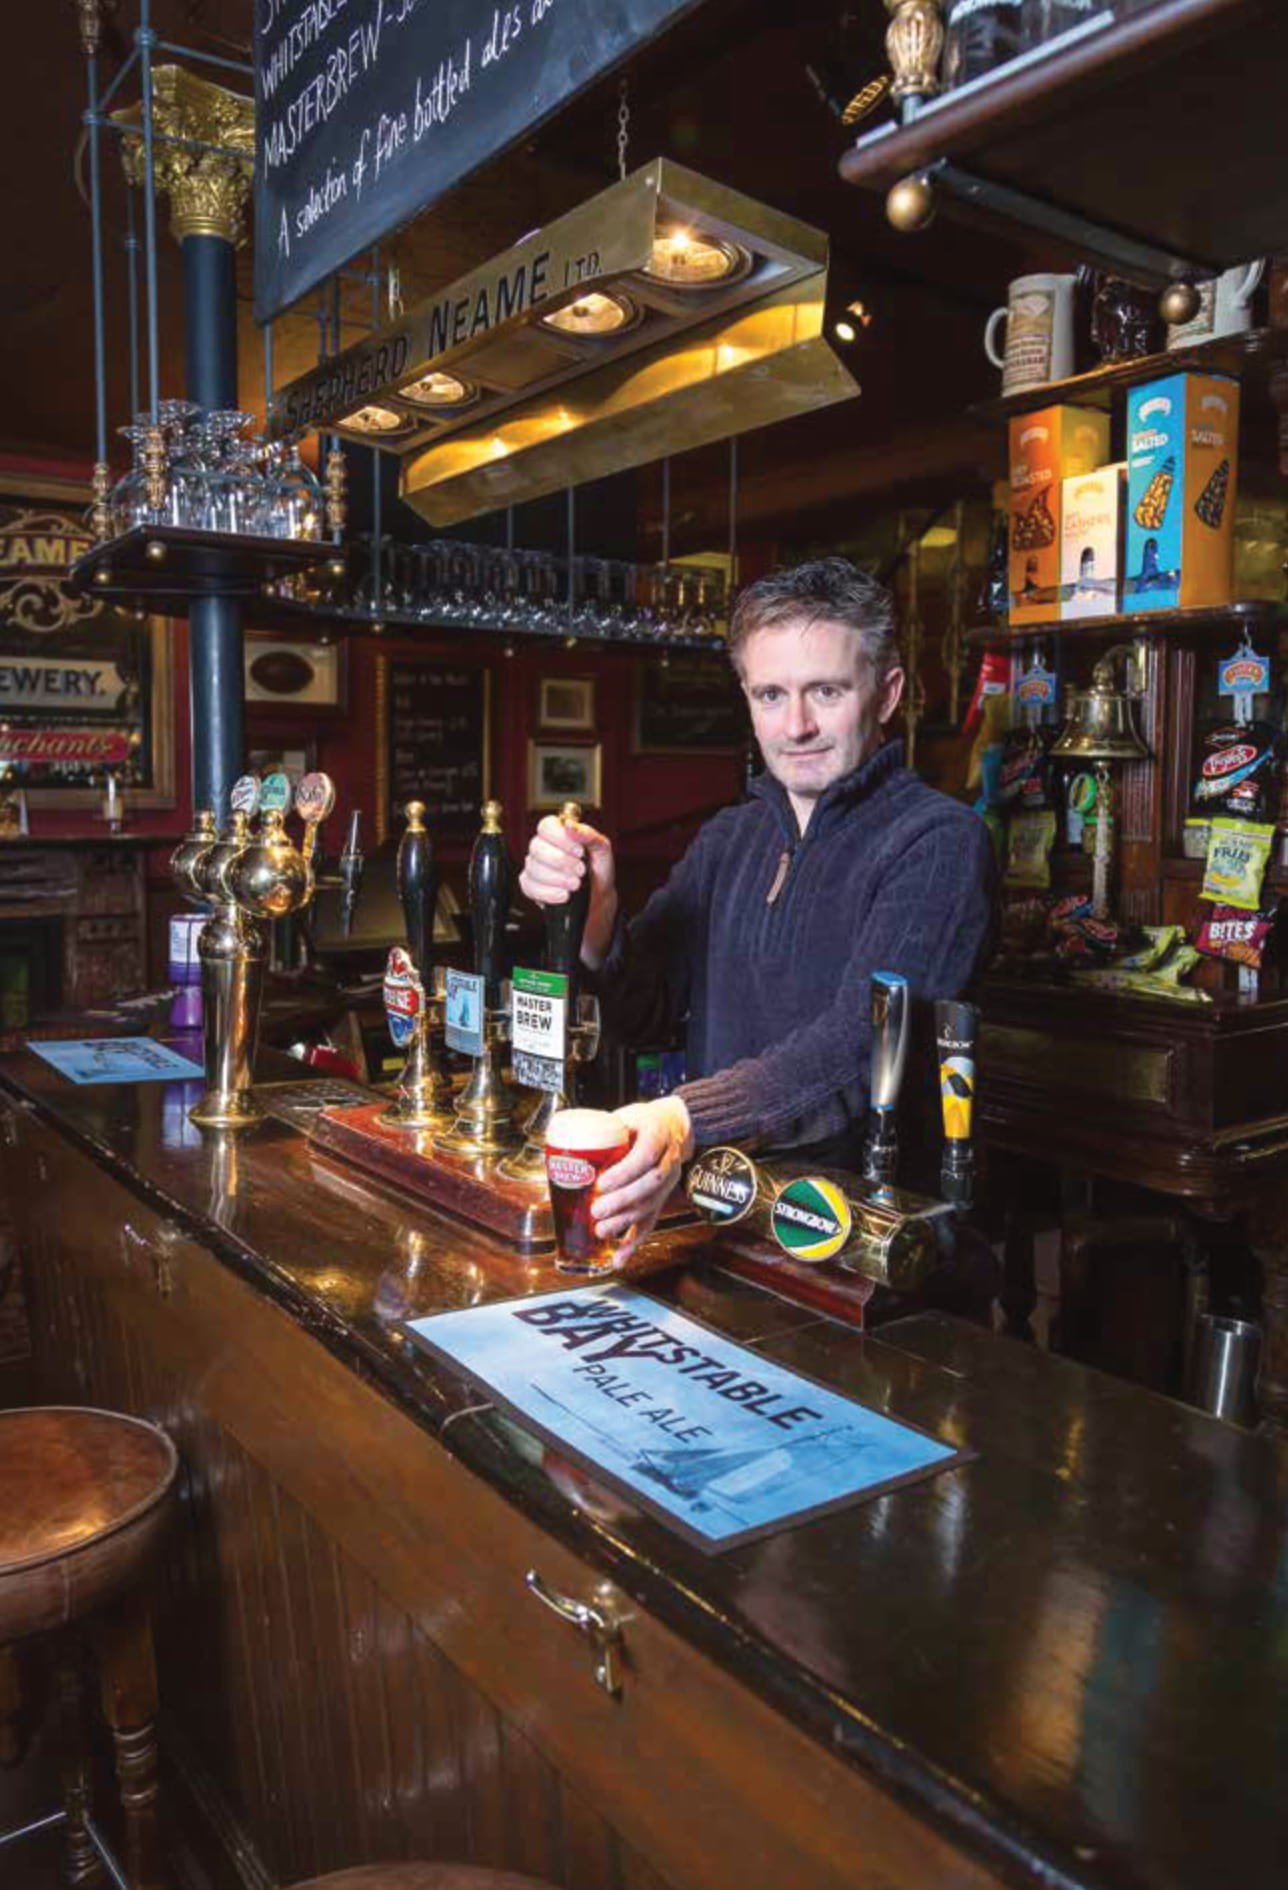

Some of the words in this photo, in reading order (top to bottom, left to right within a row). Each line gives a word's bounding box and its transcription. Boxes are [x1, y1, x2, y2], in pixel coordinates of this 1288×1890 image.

[278, 207, 290, 257] A
[352, 128, 371, 201] of
[374, 112, 407, 182] fine
[413, 58, 470, 141] bottled
[482, 9, 522, 68] ales
[428, 252, 550, 359] NEAME
[1209, 919, 1258, 942] BITES
[517, 994, 553, 1013] MASTER
[517, 1010, 552, 1031] BREW
[511, 1302, 660, 1364] BAY
[587, 1300, 823, 1430] WHITSTABLE
[572, 1363, 654, 1408] PALE
[638, 1407, 713, 1444] ALE
